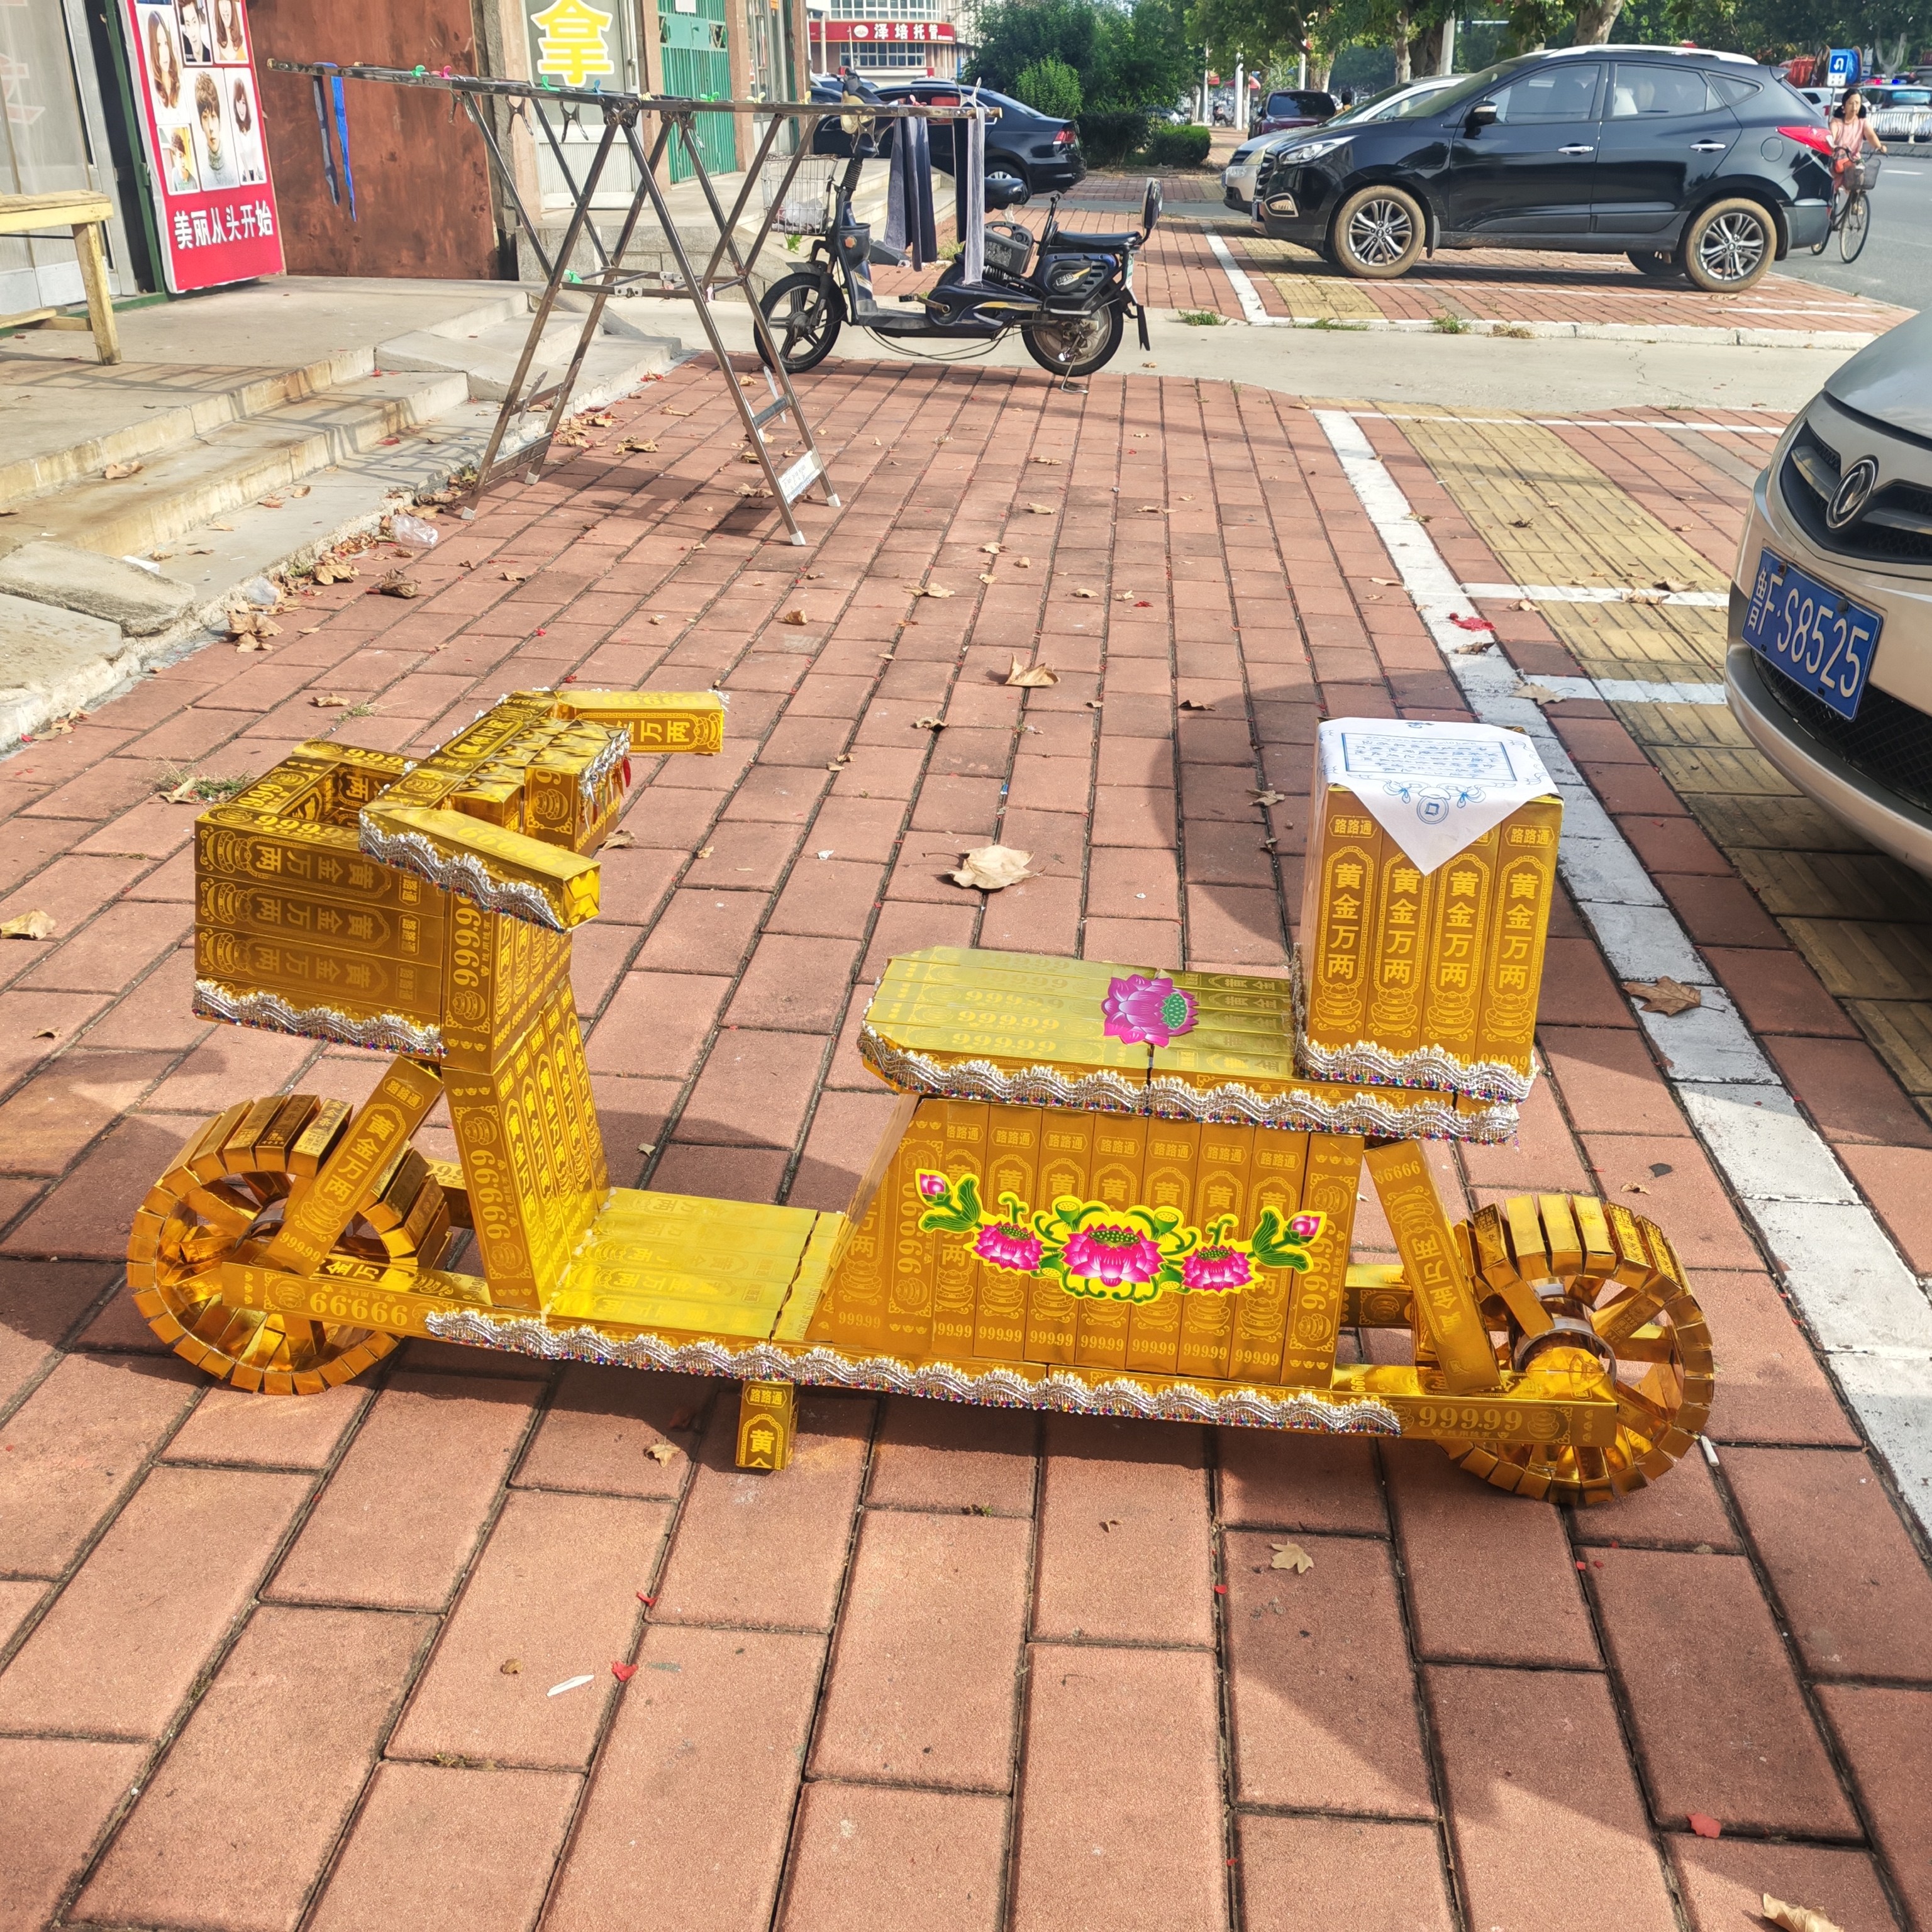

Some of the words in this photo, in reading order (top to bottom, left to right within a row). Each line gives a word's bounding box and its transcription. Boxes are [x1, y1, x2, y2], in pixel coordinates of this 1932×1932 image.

[874, 23, 938, 40] 泽培托管
[532, 0, 613, 86] 拿
[174, 200, 274, 249] 美丽从头开始
[1334, 818, 1372, 836] 路路通
[1510, 828, 1550, 845] 路路通
[255, 845, 374, 889] 黄金万两
[256, 896, 373, 940] 黄金万两
[1328, 863, 1363, 979] 黄金万两
[1383, 867, 1421, 984] 黄金万两
[1440, 870, 1479, 987] 黄金万两
[1498, 872, 1539, 990] 黄金万两
[255, 946, 372, 989] 黄金万两
[386, 1080, 423, 1108] 路路通
[996, 1130, 1031, 1146] 路路通
[1048, 1134, 1083, 1151] 路路通
[1101, 1139, 1135, 1155] 路路通
[1154, 1142, 1189, 1159] 路路通
[1207, 1146, 1242, 1163] 路路通
[323, 1113, 395, 1202] 黄金万两
[1260, 1152, 1296, 1169] 路路通
[279, 1231, 321, 1262] 999.99
[838, 1311, 881, 1329] 999.99
[979, 1326, 1023, 1343] 999.99
[1030, 1330, 1074, 1346] 999.99
[1080, 1335, 1124, 1352] 999.99
[1132, 1339, 1176, 1356] 999.99
[1184, 1343, 1228, 1360] 999.99
[1235, 1349, 1279, 1366] 999.99
[750, 1389, 783, 1406] 路路通
[1418, 1406, 1523, 1431] 999.99
